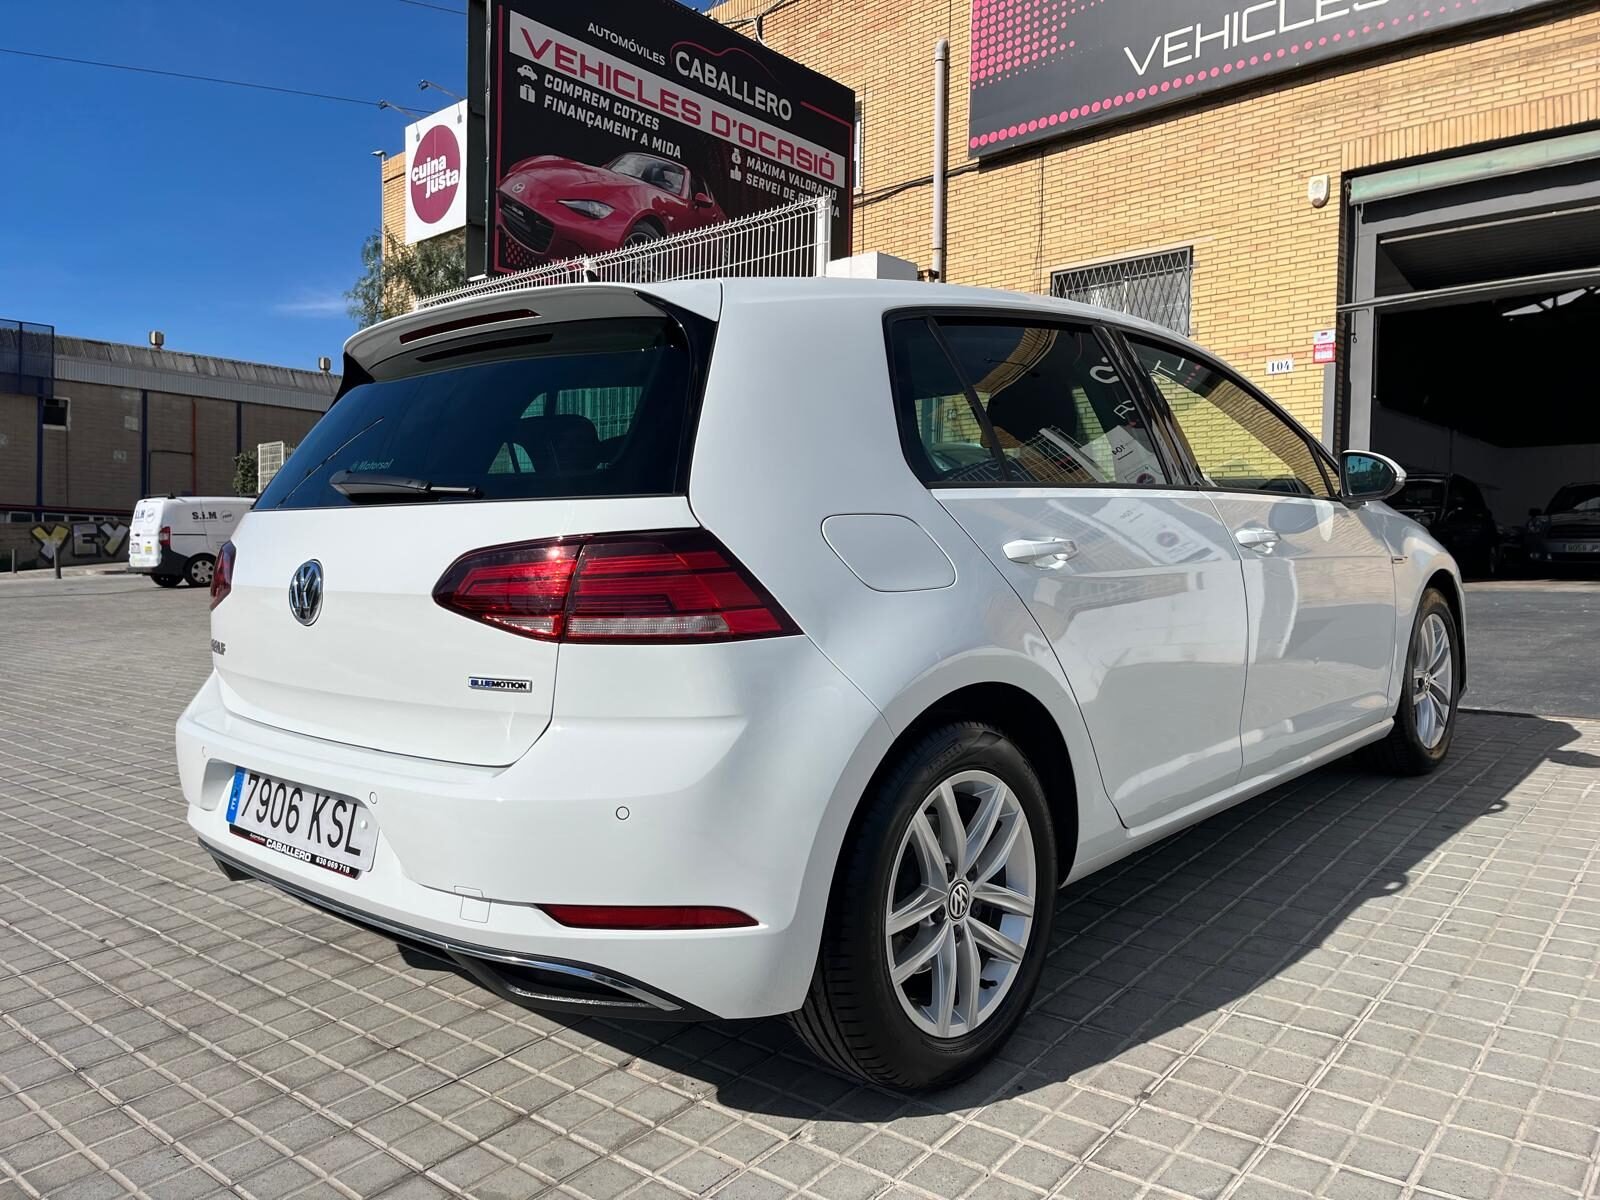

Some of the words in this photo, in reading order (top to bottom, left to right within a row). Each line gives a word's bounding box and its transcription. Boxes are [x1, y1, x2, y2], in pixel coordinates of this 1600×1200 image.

[587, 22, 666, 66] AUTOMÓVILES
[675, 51, 793, 121] CABALLERO
[520, 27, 702, 126] VEHICLES
[711, 110, 835, 181] D'OCASIÓ
[544, 73, 610, 112] COMPREM
[613, 101, 660, 131] COTXES
[544, 94, 639, 142] FINANÇAMENT
[640, 132, 649, 147] A
[652, 138, 682, 159] MIDA
[411, 155, 447, 182] cuina
[425, 168, 460, 199] justa
[746, 155, 787, 183] MÀXIMA
[746, 173, 781, 195] SERVEI
[783, 187, 796, 201] DE
[1271, 361, 1290, 372] 104
[31, 523, 129, 560] YEY
[470, 679, 527, 690] BLUEMOTION
[241, 773, 304, 834] 7906
[307, 792, 362, 857] KSL
[266, 838, 312, 862] CABALLERO
